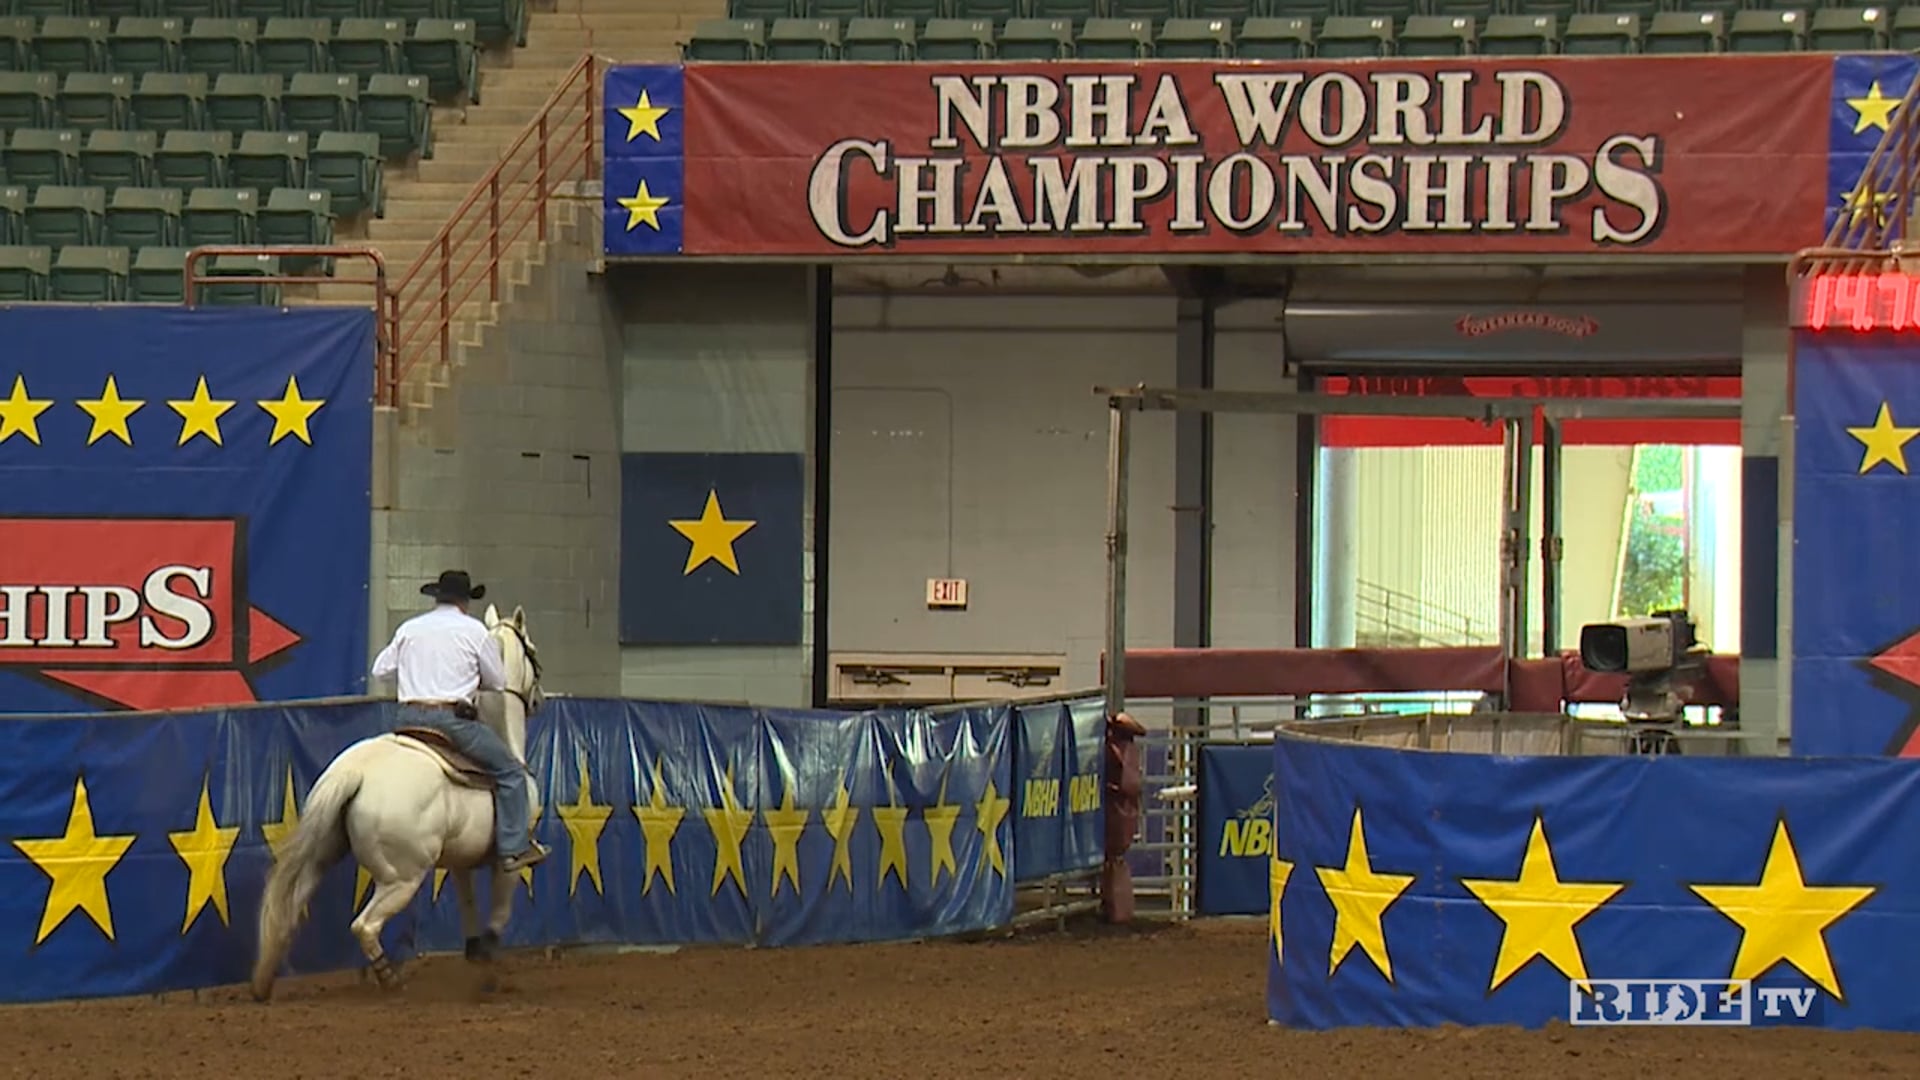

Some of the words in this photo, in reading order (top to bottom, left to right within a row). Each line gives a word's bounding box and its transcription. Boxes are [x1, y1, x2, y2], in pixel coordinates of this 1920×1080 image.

[931, 73, 1198, 149] NBHA
[1214, 71, 1566, 147] WORLD
[808, 135, 1662, 247] CHAMPIONSHIPS
[1812, 272, 1920, 331] 14.7
[934, 580, 959, 601] EXIT
[1022, 778, 1059, 817] NBHA
[1068, 773, 1100, 813] NBH
